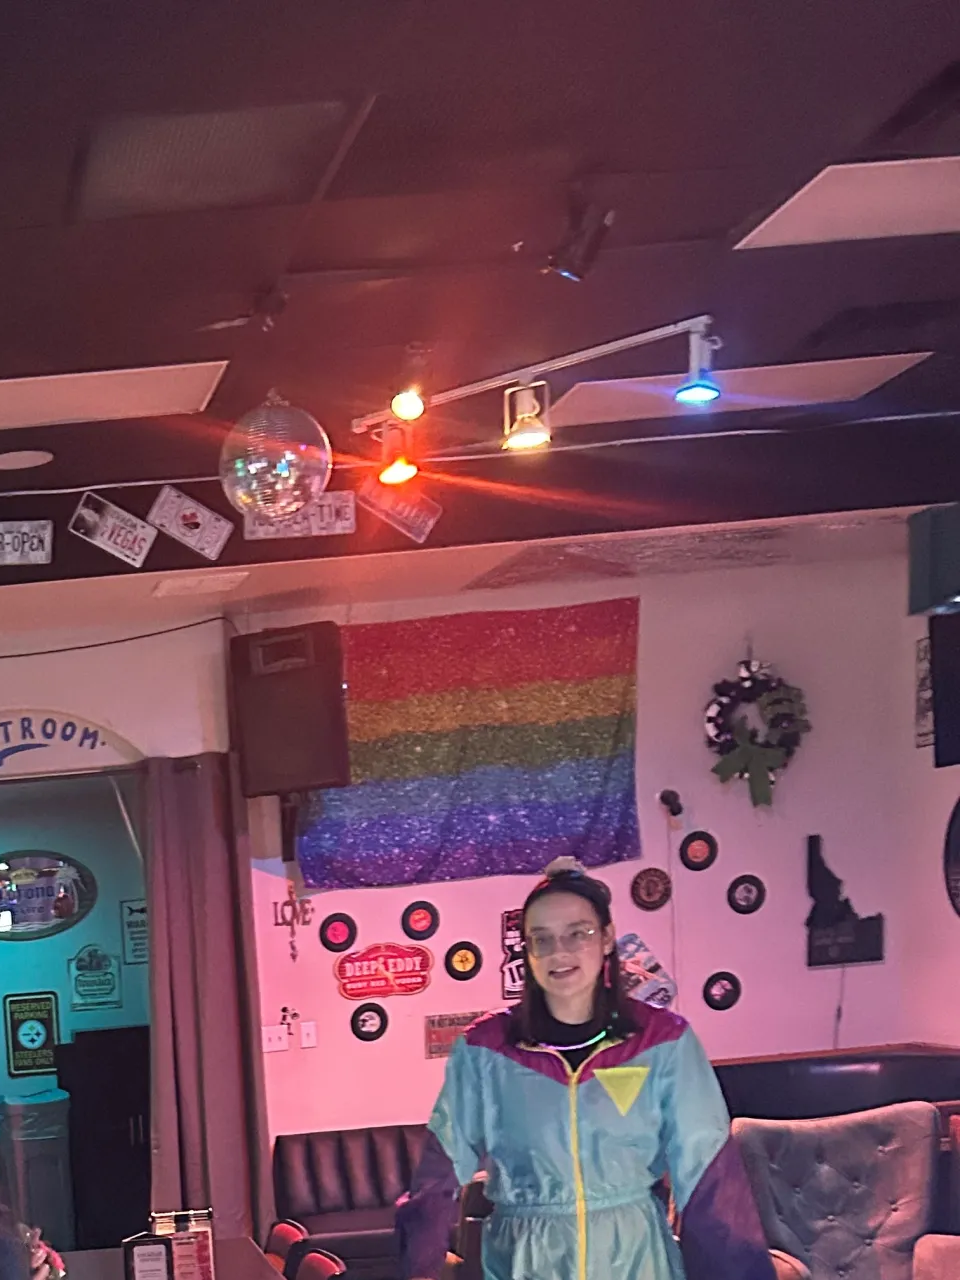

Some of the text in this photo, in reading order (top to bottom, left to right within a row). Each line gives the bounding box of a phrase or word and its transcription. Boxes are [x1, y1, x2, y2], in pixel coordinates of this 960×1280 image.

[106, 523, 147, 557] VEGAS
[273, 899, 313, 927] LOVE
[389, 956, 423, 973] EDDY
